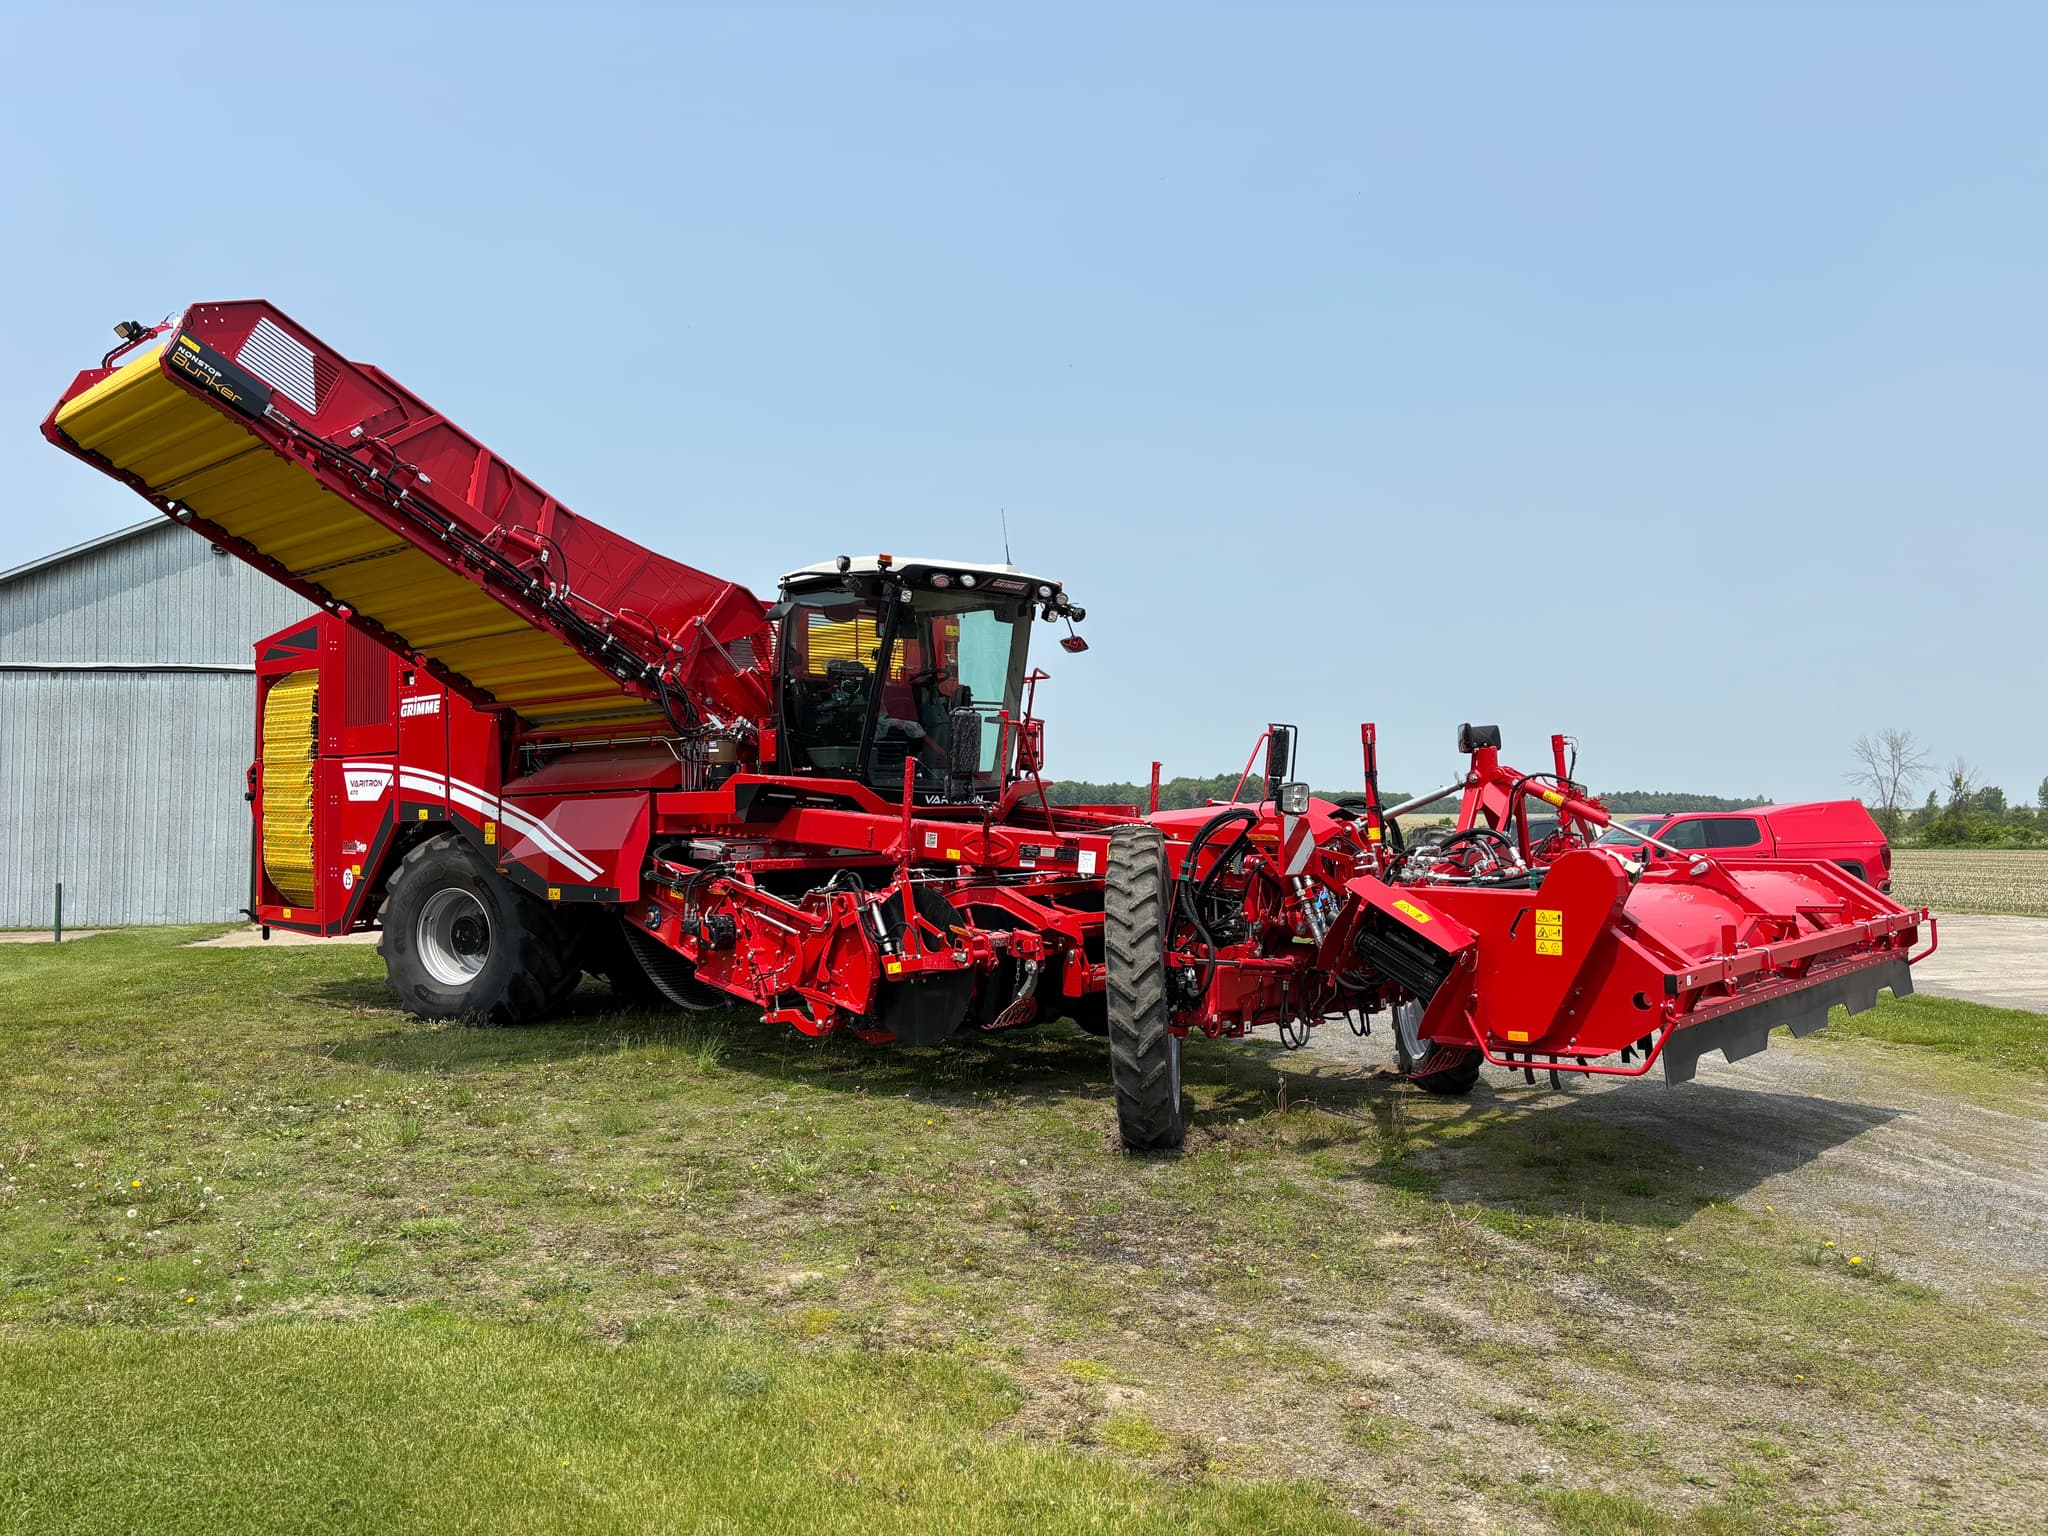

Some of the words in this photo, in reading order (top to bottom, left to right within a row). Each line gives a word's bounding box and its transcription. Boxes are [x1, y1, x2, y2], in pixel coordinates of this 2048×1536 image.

[177, 346, 222, 377] NONSTOP
[172, 351, 243, 402] Bunker
[401, 697, 441, 718] GRIMME
[350, 780, 382, 788] VARITRON
